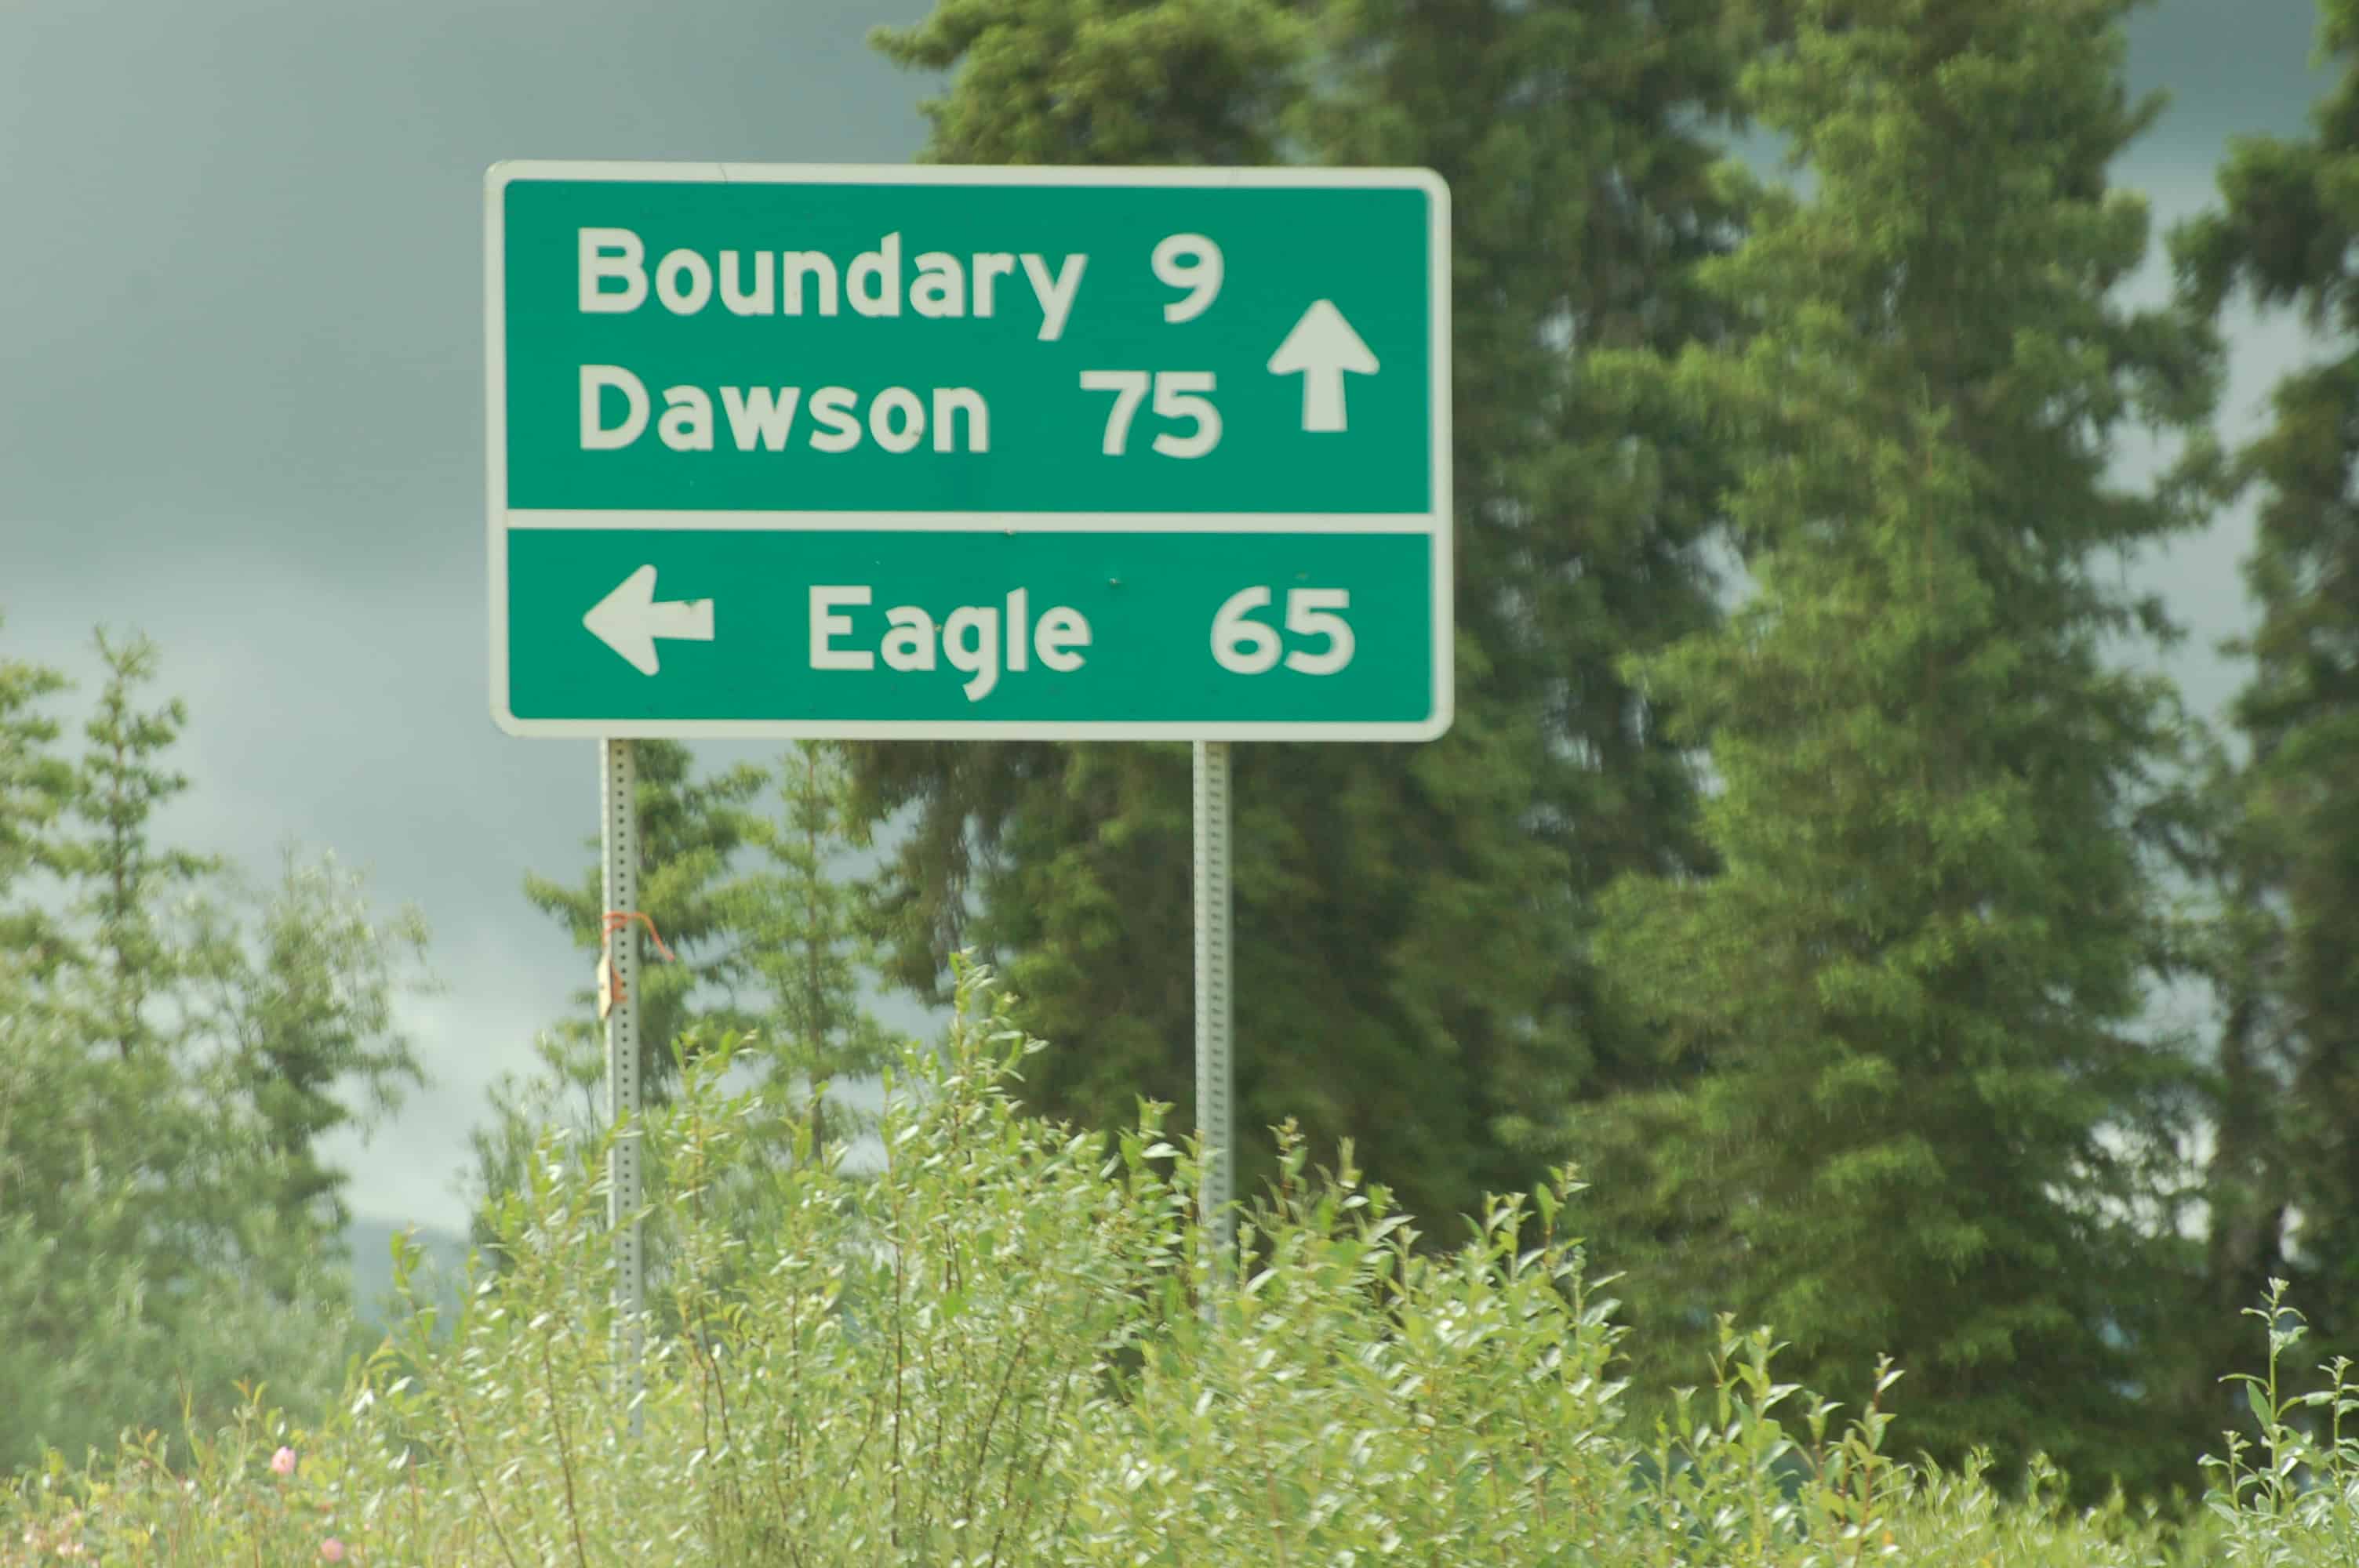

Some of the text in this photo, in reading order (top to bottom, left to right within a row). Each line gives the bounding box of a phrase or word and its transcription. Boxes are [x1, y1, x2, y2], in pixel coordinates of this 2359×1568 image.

[579, 227, 1223, 341] Boundary 9
[580, 364, 1221, 458] Dawson 75
[809, 585, 1354, 702] Eagle 65
